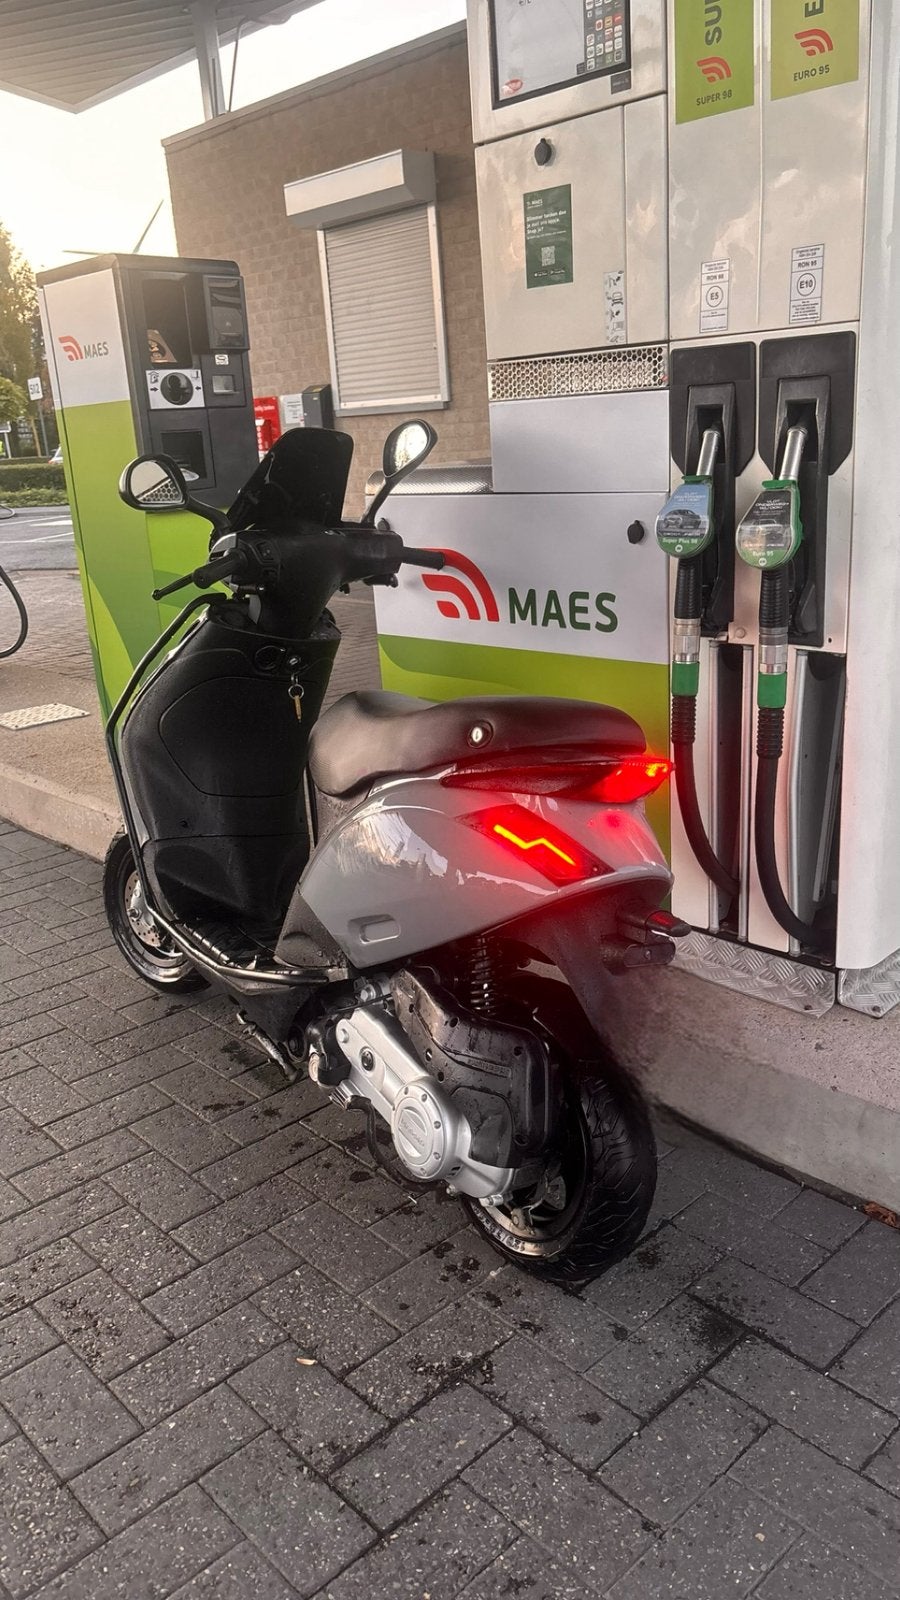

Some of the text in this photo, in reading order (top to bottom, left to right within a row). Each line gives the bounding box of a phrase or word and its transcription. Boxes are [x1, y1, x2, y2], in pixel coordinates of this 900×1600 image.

[793, 64, 830, 81] EURO 95
[696, 89, 732, 106] SUPER 98
[799, 279, 813, 289] E10
[710, 291, 719, 301] E5
[83, 341, 109, 359] MAES
[508, 587, 618, 633] MAES
